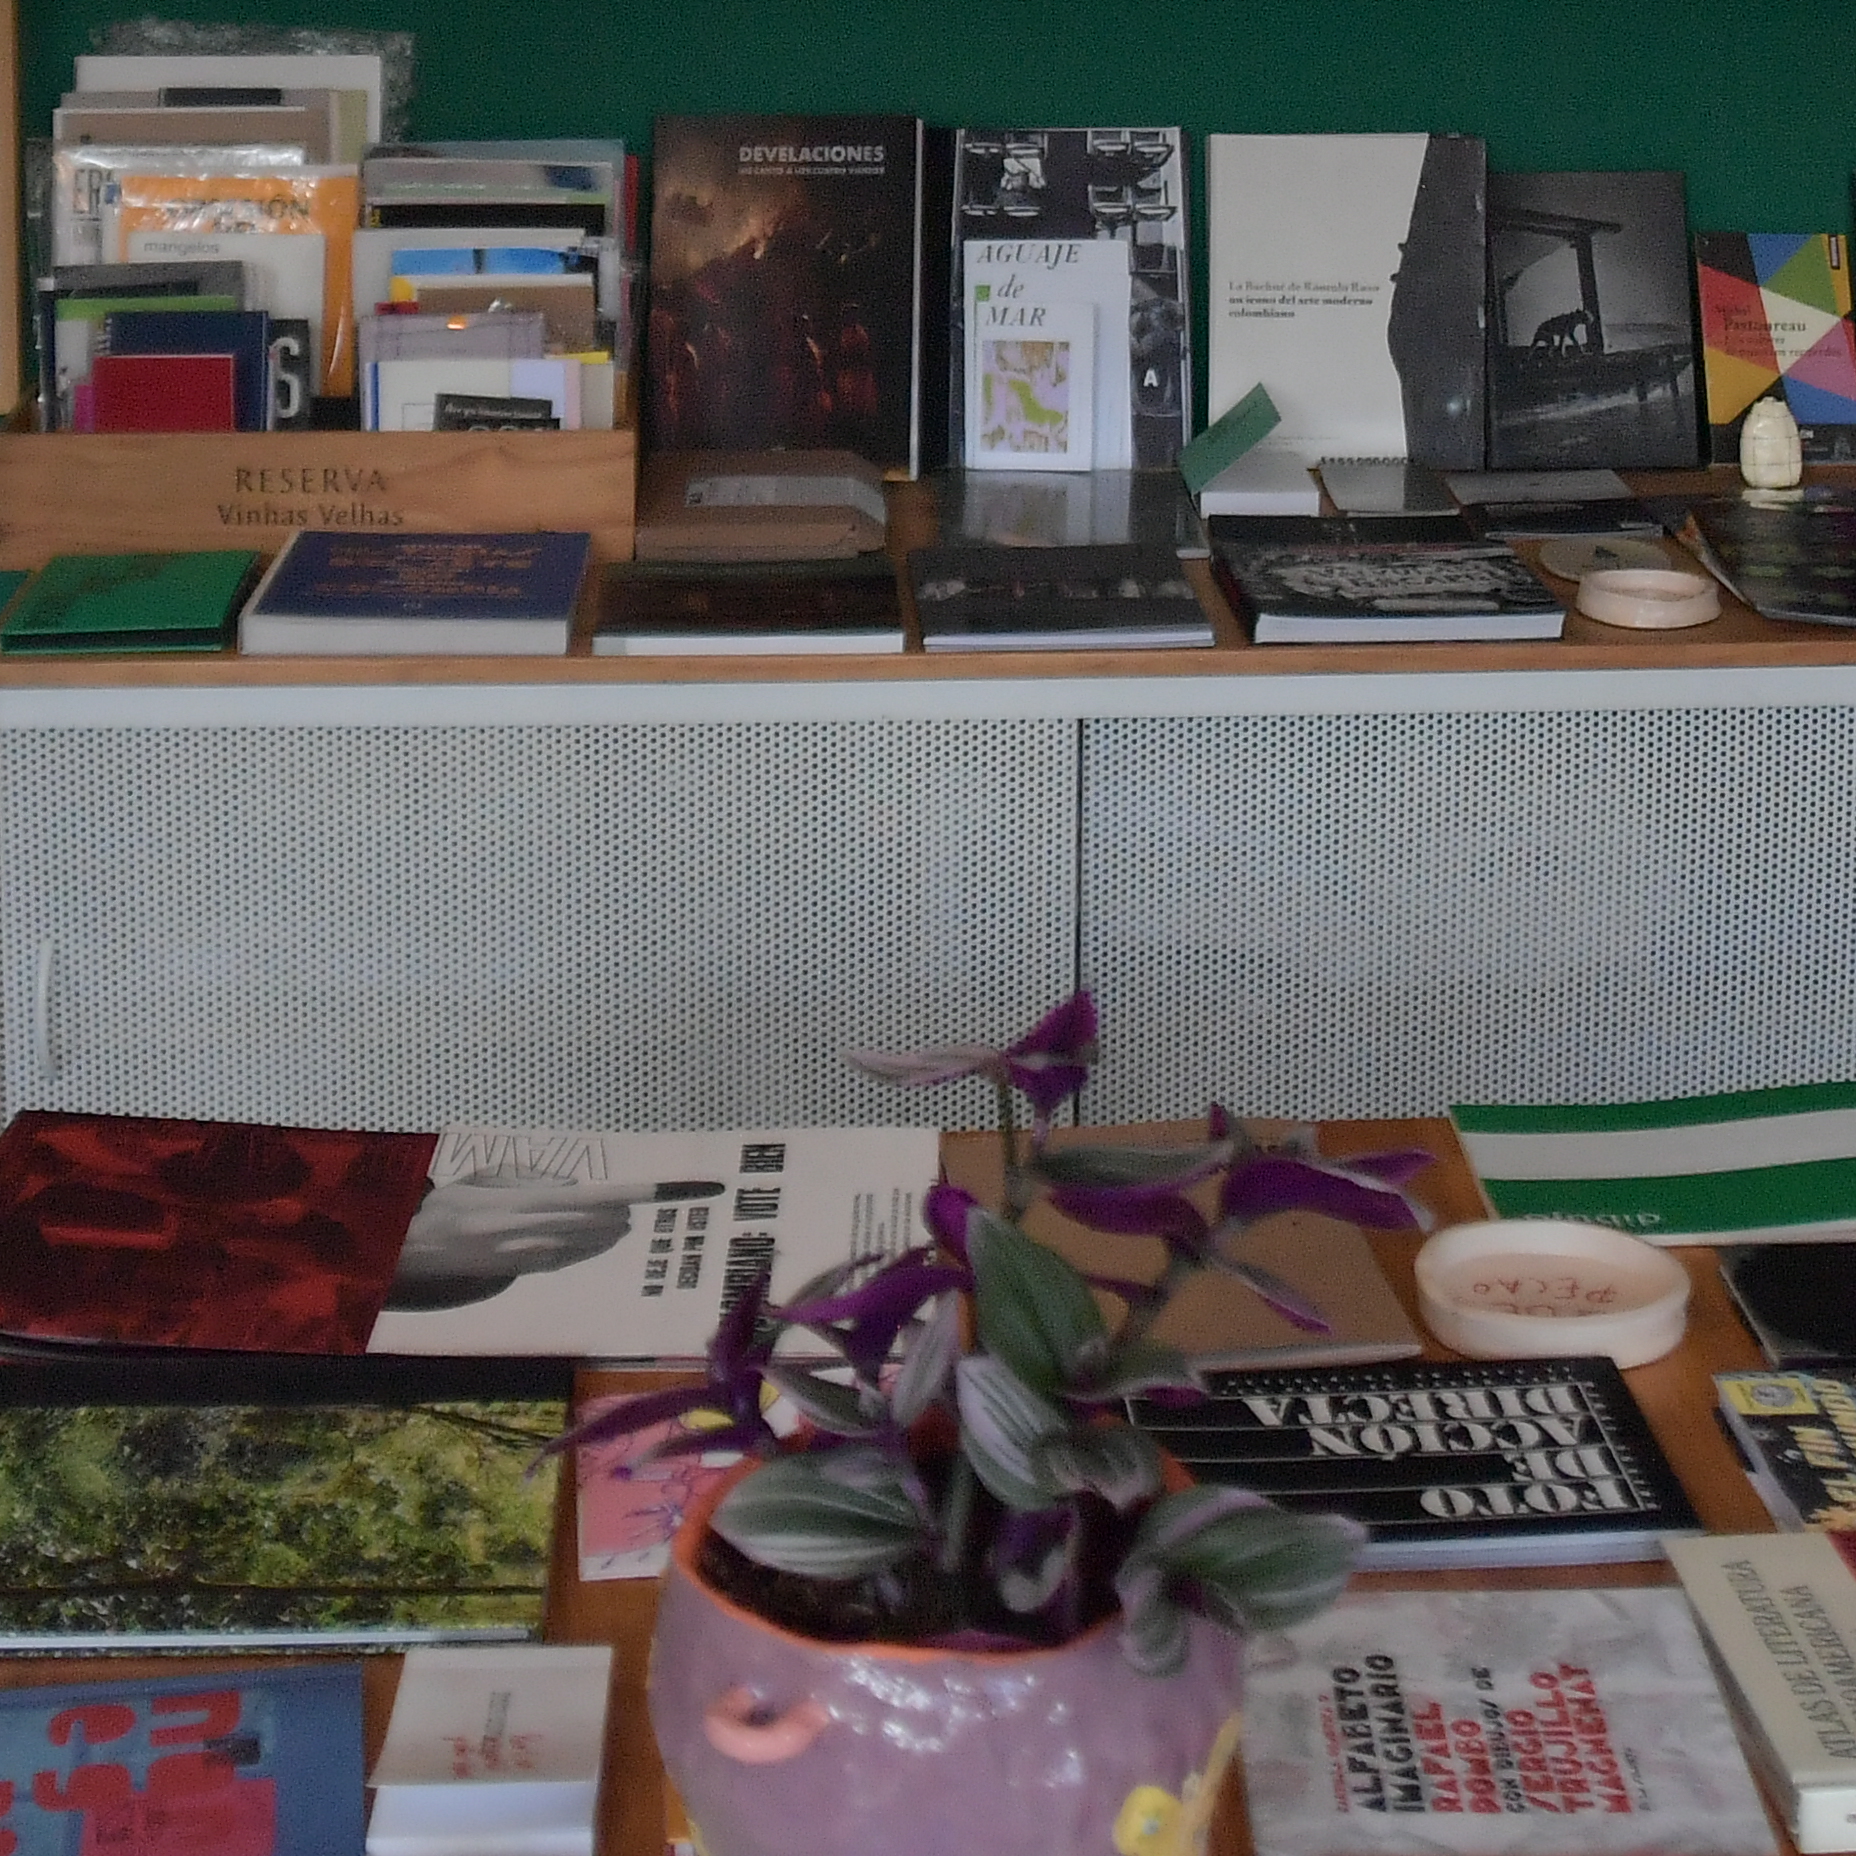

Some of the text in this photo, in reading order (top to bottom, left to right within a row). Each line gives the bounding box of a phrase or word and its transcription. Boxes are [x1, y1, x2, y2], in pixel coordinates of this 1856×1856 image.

[738, 145, 885, 164] DEVELACIONES
[976, 244, 1081, 265] AGUAJE
[997, 276, 1023, 299] de
[984, 305, 1047, 328] MAR
[1143, 369, 1158, 388] A
[234, 467, 389, 494] RESERVA
[216, 504, 404, 528] Vinhas Velhas
[739, 1142, 787, 1174] BIEN
[732, 1186, 782, 1222] VOTE
[1244, 1385, 1584, 1427] DIRECTA
[1506, 1447, 1621, 1482] DE
[1419, 1480, 1637, 1519] FOTO
[1723, 1559, 1811, 1666] LITERATURA
[1471, 1666, 1494, 1692] DE
[1331, 1666, 1388, 1813] ALFABETO
[1364, 1654, 1426, 1813] IMAGINARIO
[1528, 1670, 1596, 1814] TRUJILLO
[1558, 1661, 1632, 1814] MAGNENAT
[1411, 1700, 1465, 1813] RAFAEL
[1450, 1718, 1502, 1813] POMBO
[1504, 1708, 1562, 1813] SERGIO
[1505, 1779, 1526, 1814] CON
